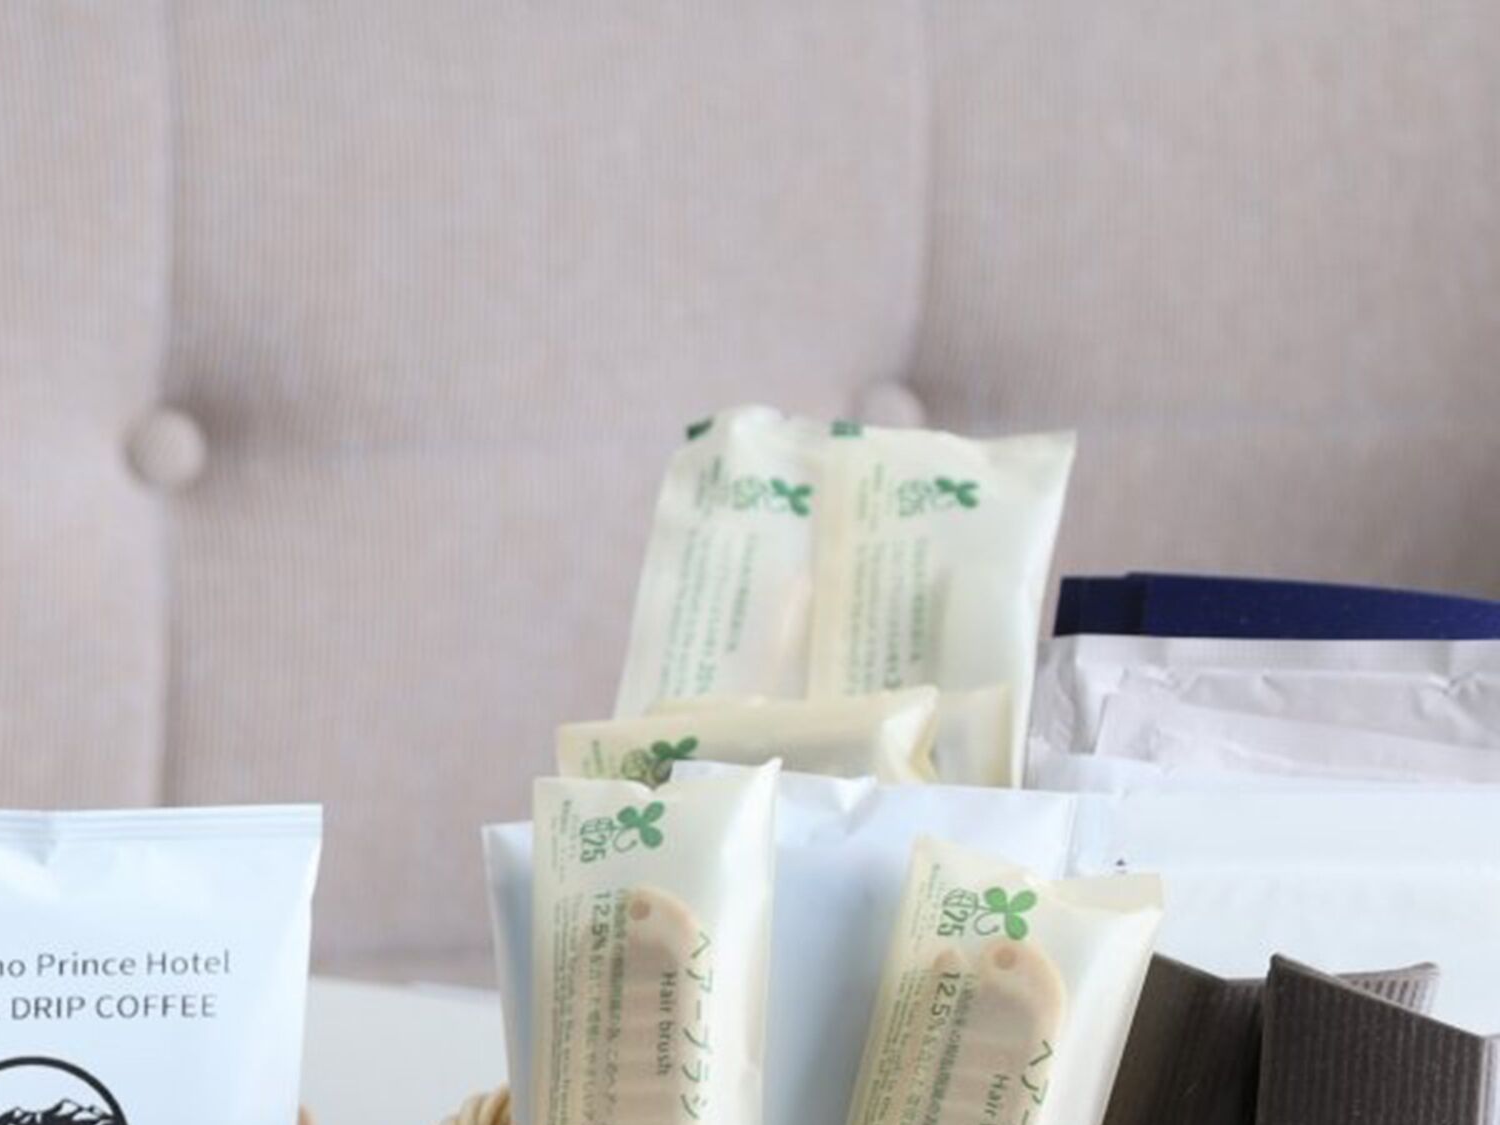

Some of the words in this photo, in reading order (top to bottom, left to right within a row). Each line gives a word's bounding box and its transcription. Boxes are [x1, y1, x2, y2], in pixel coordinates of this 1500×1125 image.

[36, 952, 138, 978] Prince
[146, 949, 231, 977] Hotel
[11, 995, 87, 1020] DRIP
[95, 993, 219, 1019] COFFEE
[659, 970, 678, 1017] Hair
[655, 1018, 676, 1077] brush
[679, 930, 714, 1121] ヘアーブラシ
[985, 1074, 1011, 1122] Hair
